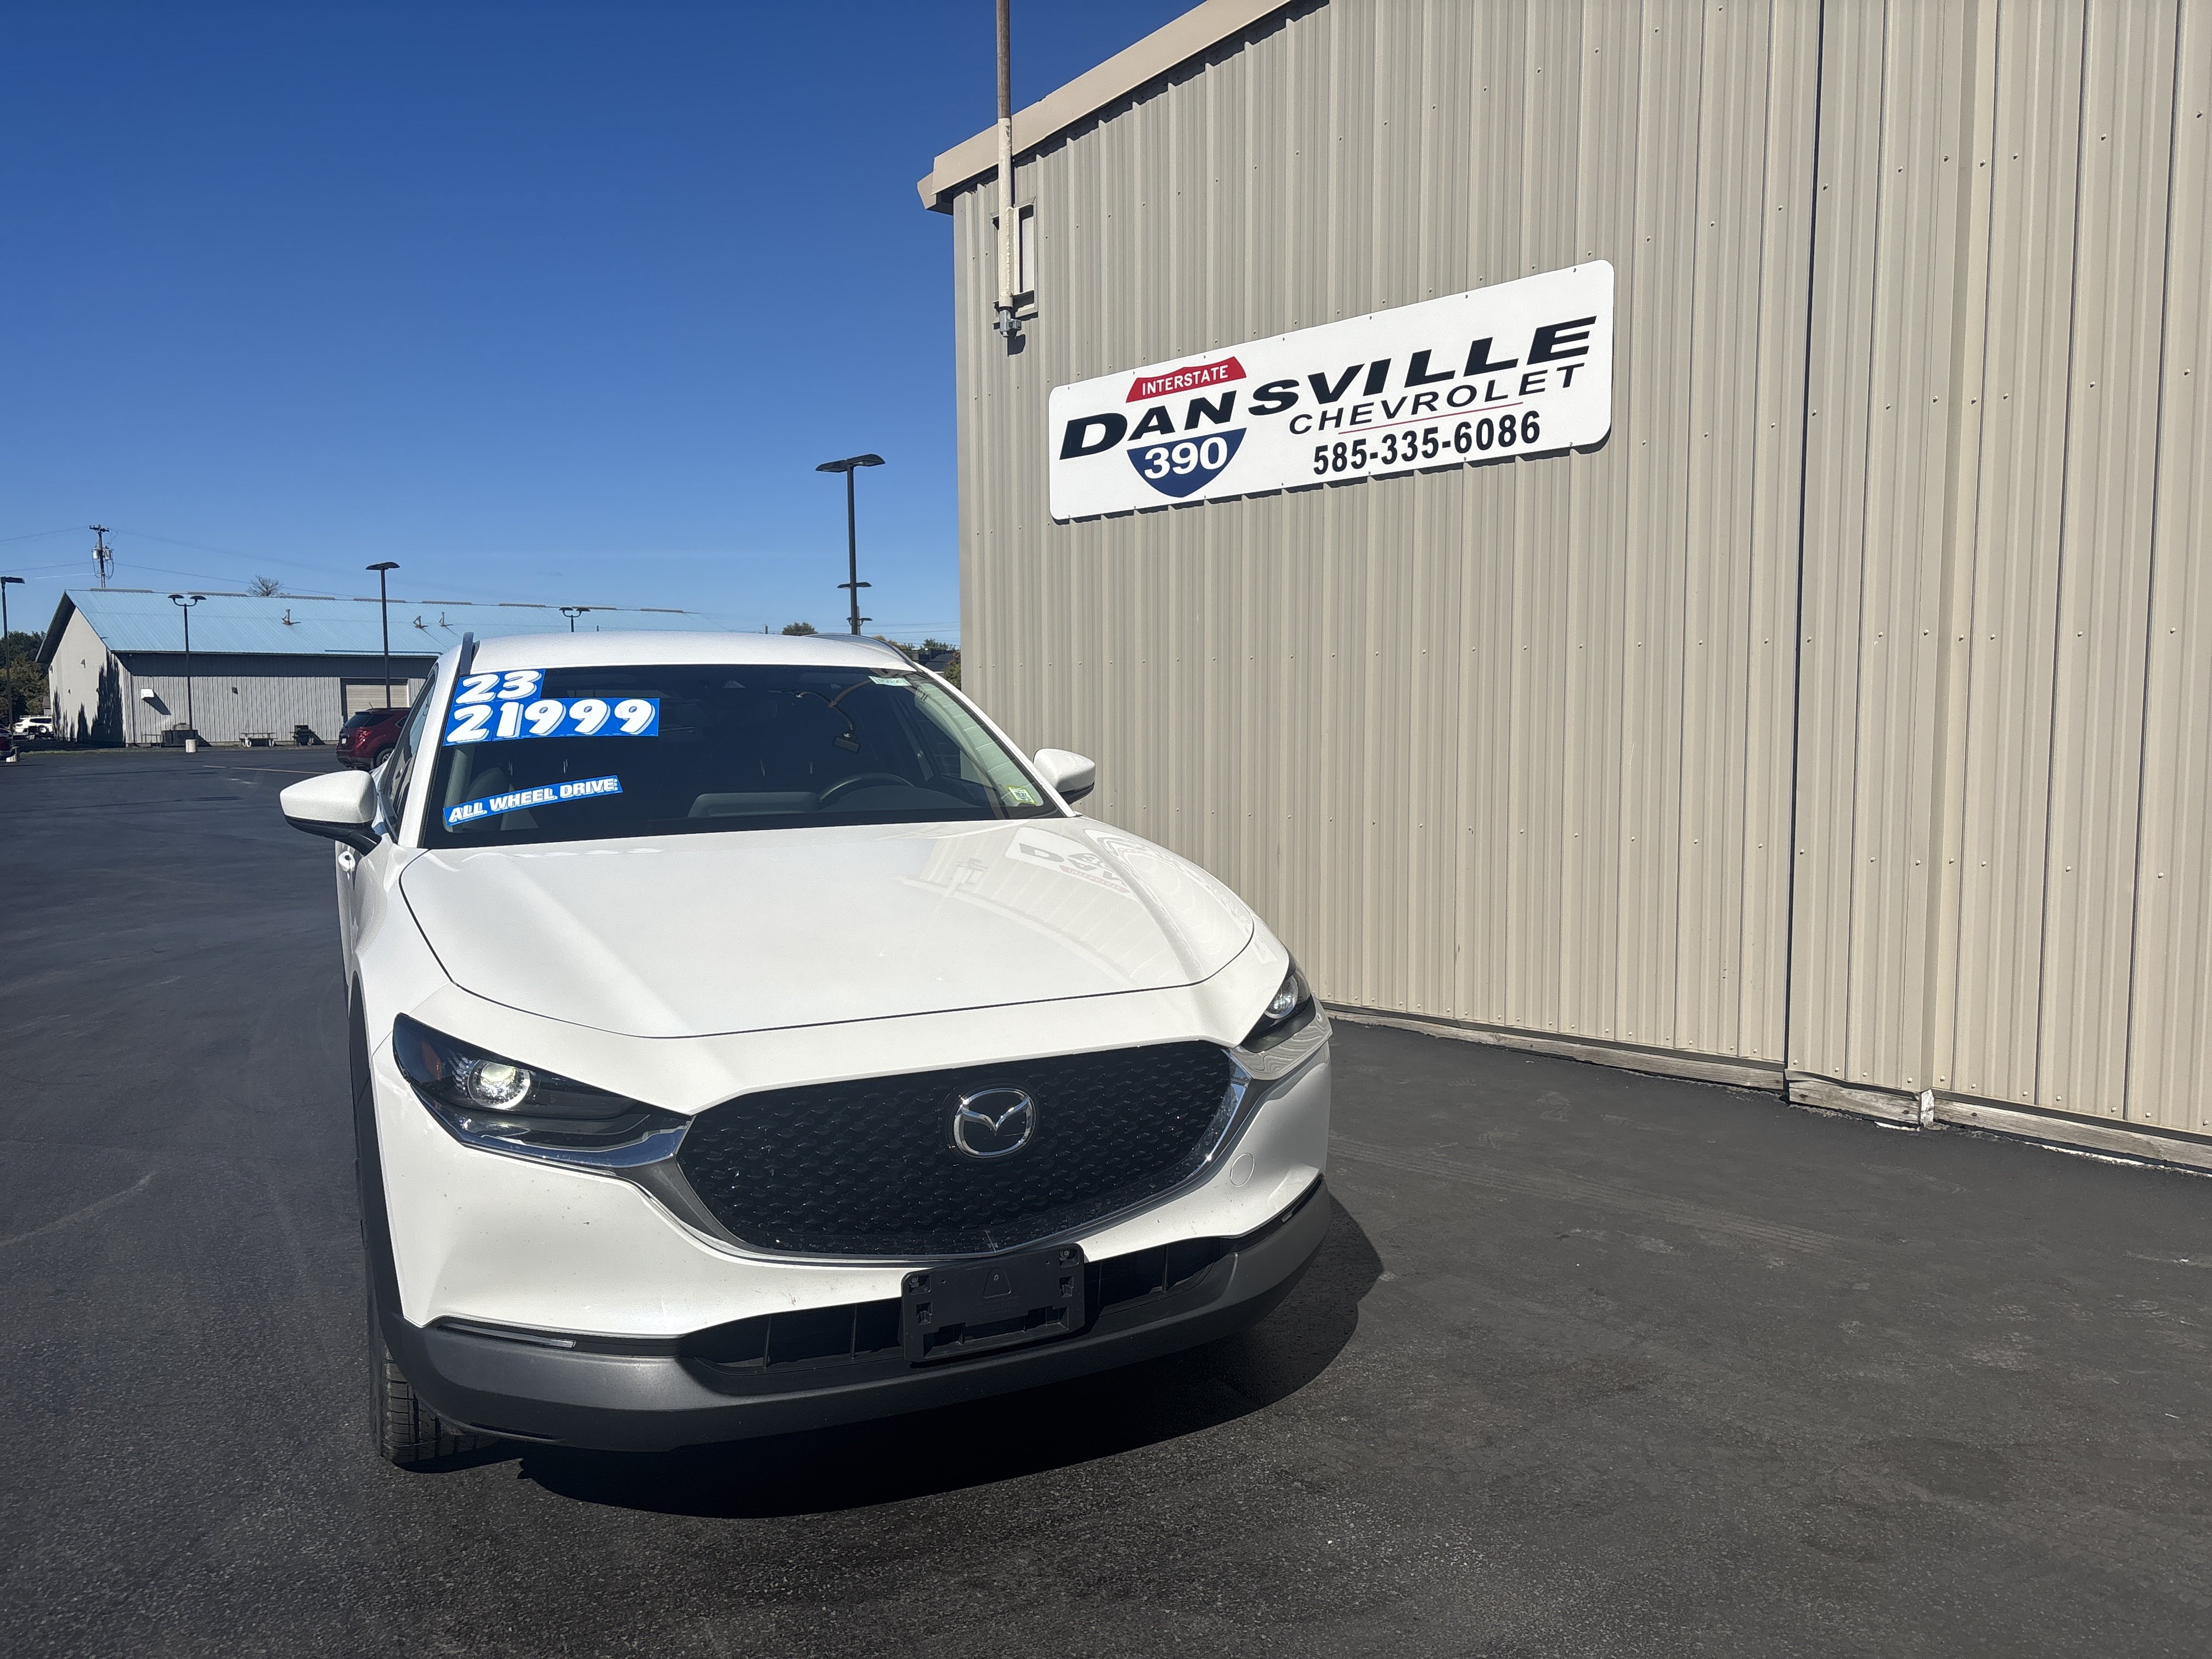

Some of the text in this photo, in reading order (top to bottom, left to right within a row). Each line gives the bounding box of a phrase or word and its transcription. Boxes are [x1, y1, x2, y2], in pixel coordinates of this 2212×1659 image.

[1142, 364, 1228, 396] INTERSTATE
[1289, 362, 1585, 435] CHEVROLET
[1144, 437, 1228, 479] 390
[1313, 410, 1541, 475] 585-335-6086
[456, 670, 542, 704] 23
[447, 699, 656, 743] 21999
[448, 777, 618, 823] ALL WHEEL DRIVE
